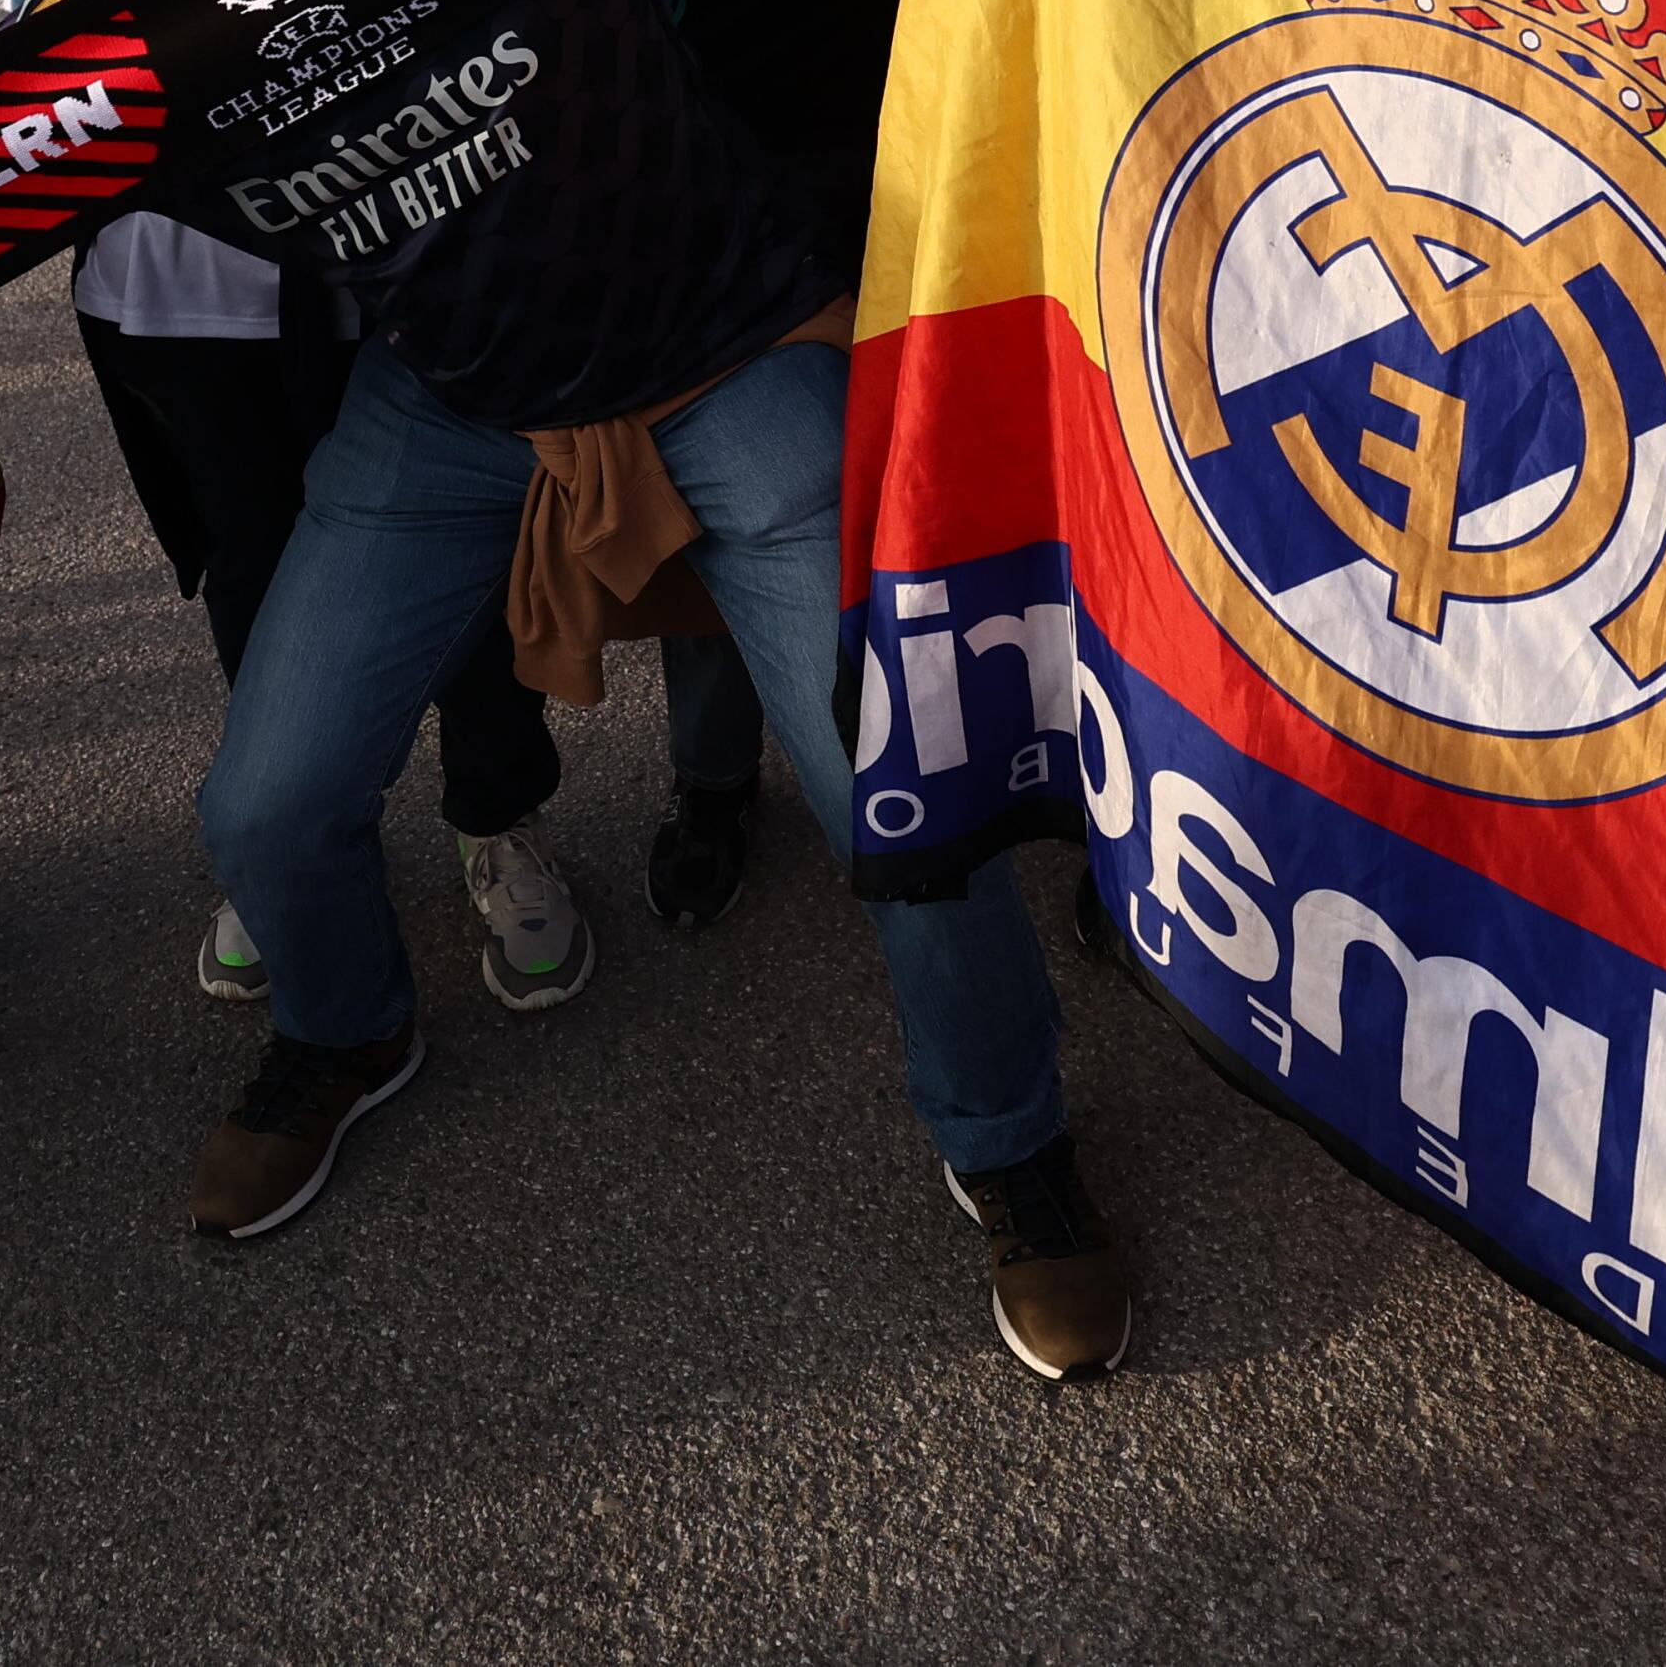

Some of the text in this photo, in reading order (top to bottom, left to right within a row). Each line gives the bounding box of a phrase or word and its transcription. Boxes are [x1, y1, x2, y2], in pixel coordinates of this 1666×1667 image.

[258, 36, 415, 137] LEAGUE
[264, 11, 349, 60] UEFA
[225, 31, 538, 233] Emirates
[320, 117, 532, 261] FLY BETTER
